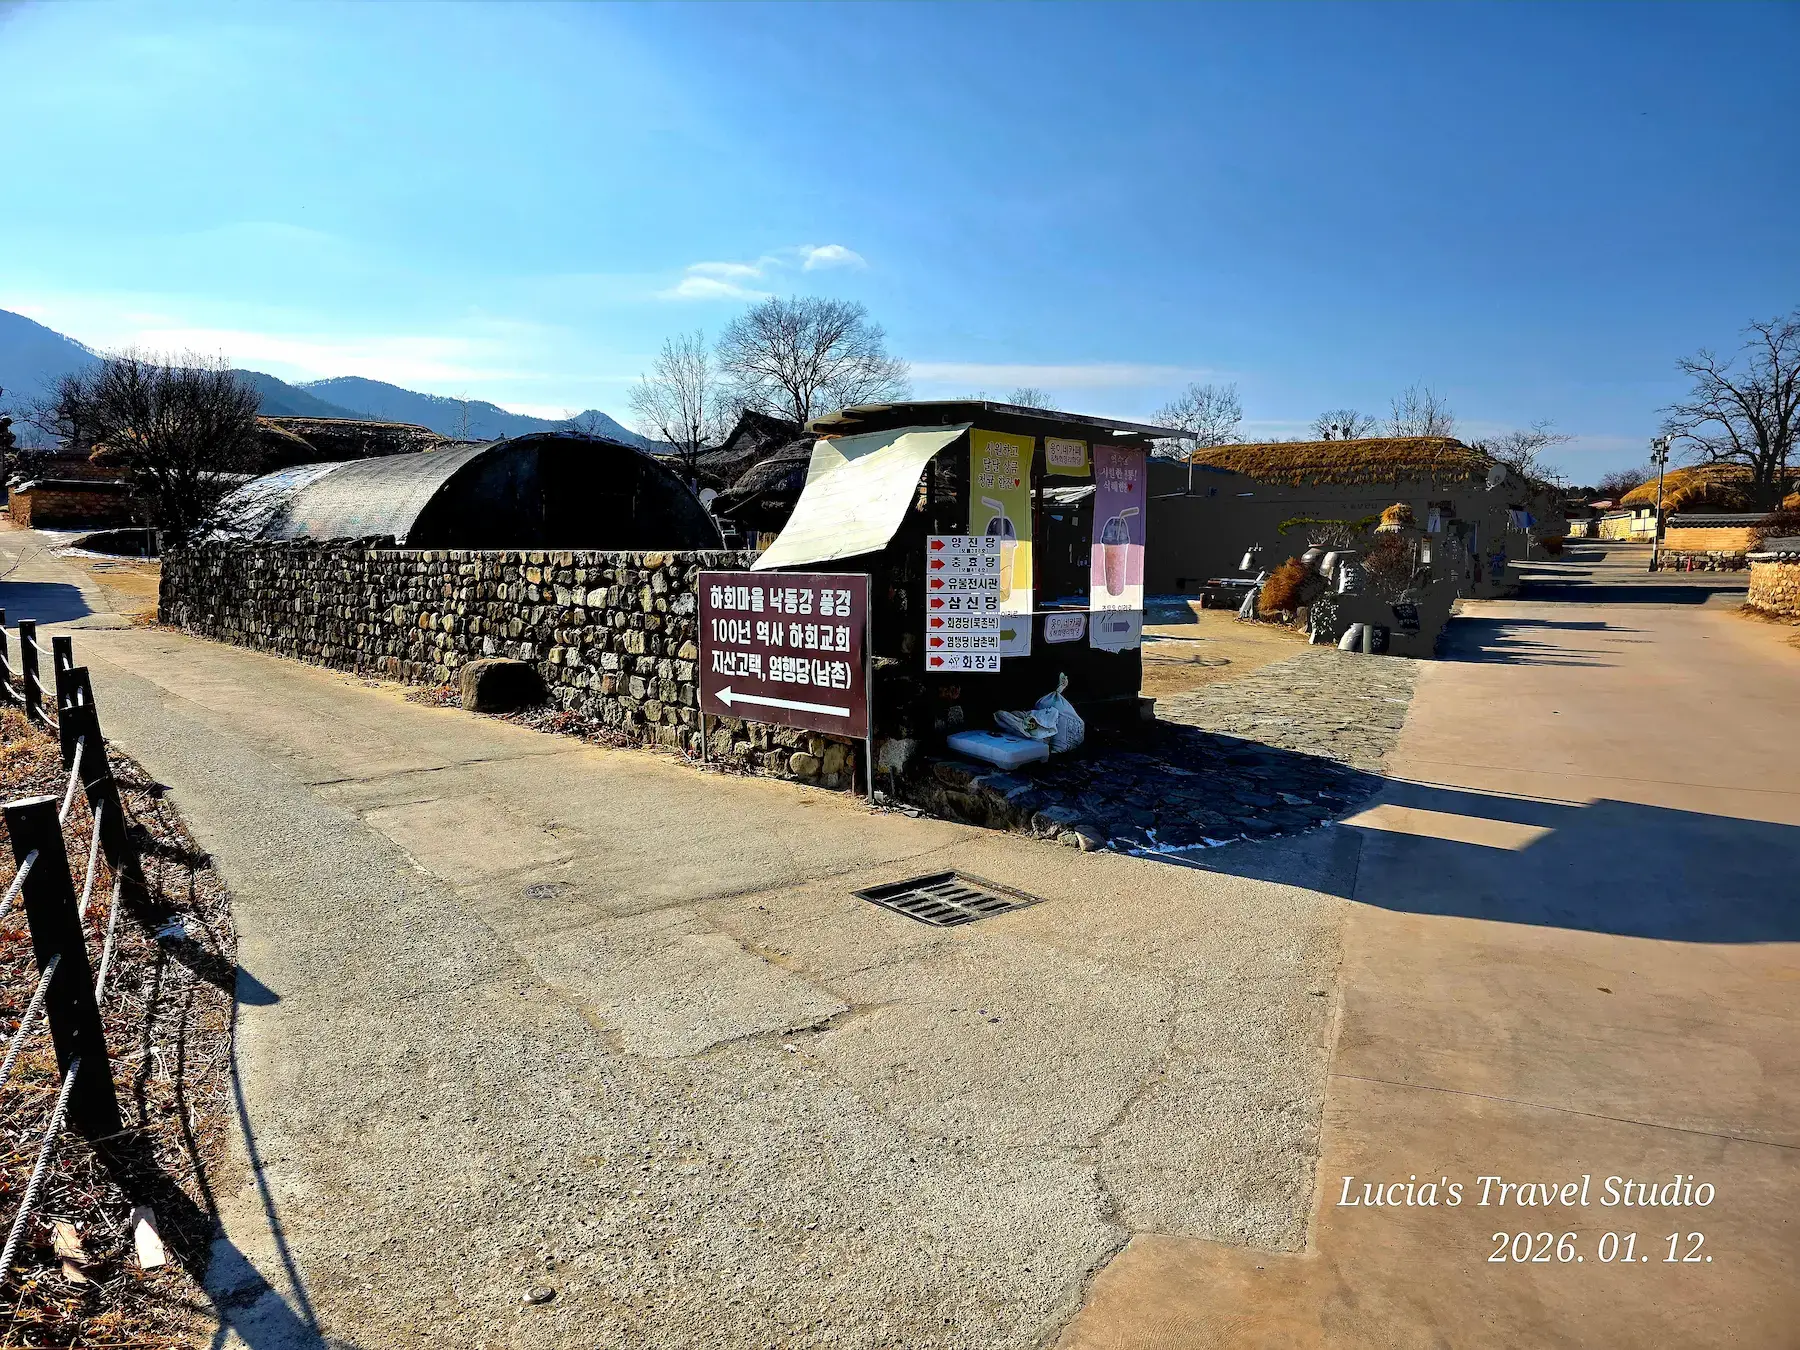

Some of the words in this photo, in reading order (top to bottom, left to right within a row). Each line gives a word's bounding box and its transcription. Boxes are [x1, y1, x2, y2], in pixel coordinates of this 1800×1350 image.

[948, 577, 998, 590] 유물전시관
[710, 585, 764, 612] 하회마을
[769, 588, 814, 615] 낙동강
[819, 589, 851, 617] 풍경
[711, 618, 751, 644] 100년
[756, 621, 784, 647] 역사
[789, 622, 850, 652] 하회교회
[711, 649, 766, 682] 지산고택,
[769, 655, 852, 690] 염행당(남촌)
[962, 655, 997, 669] 화장실
